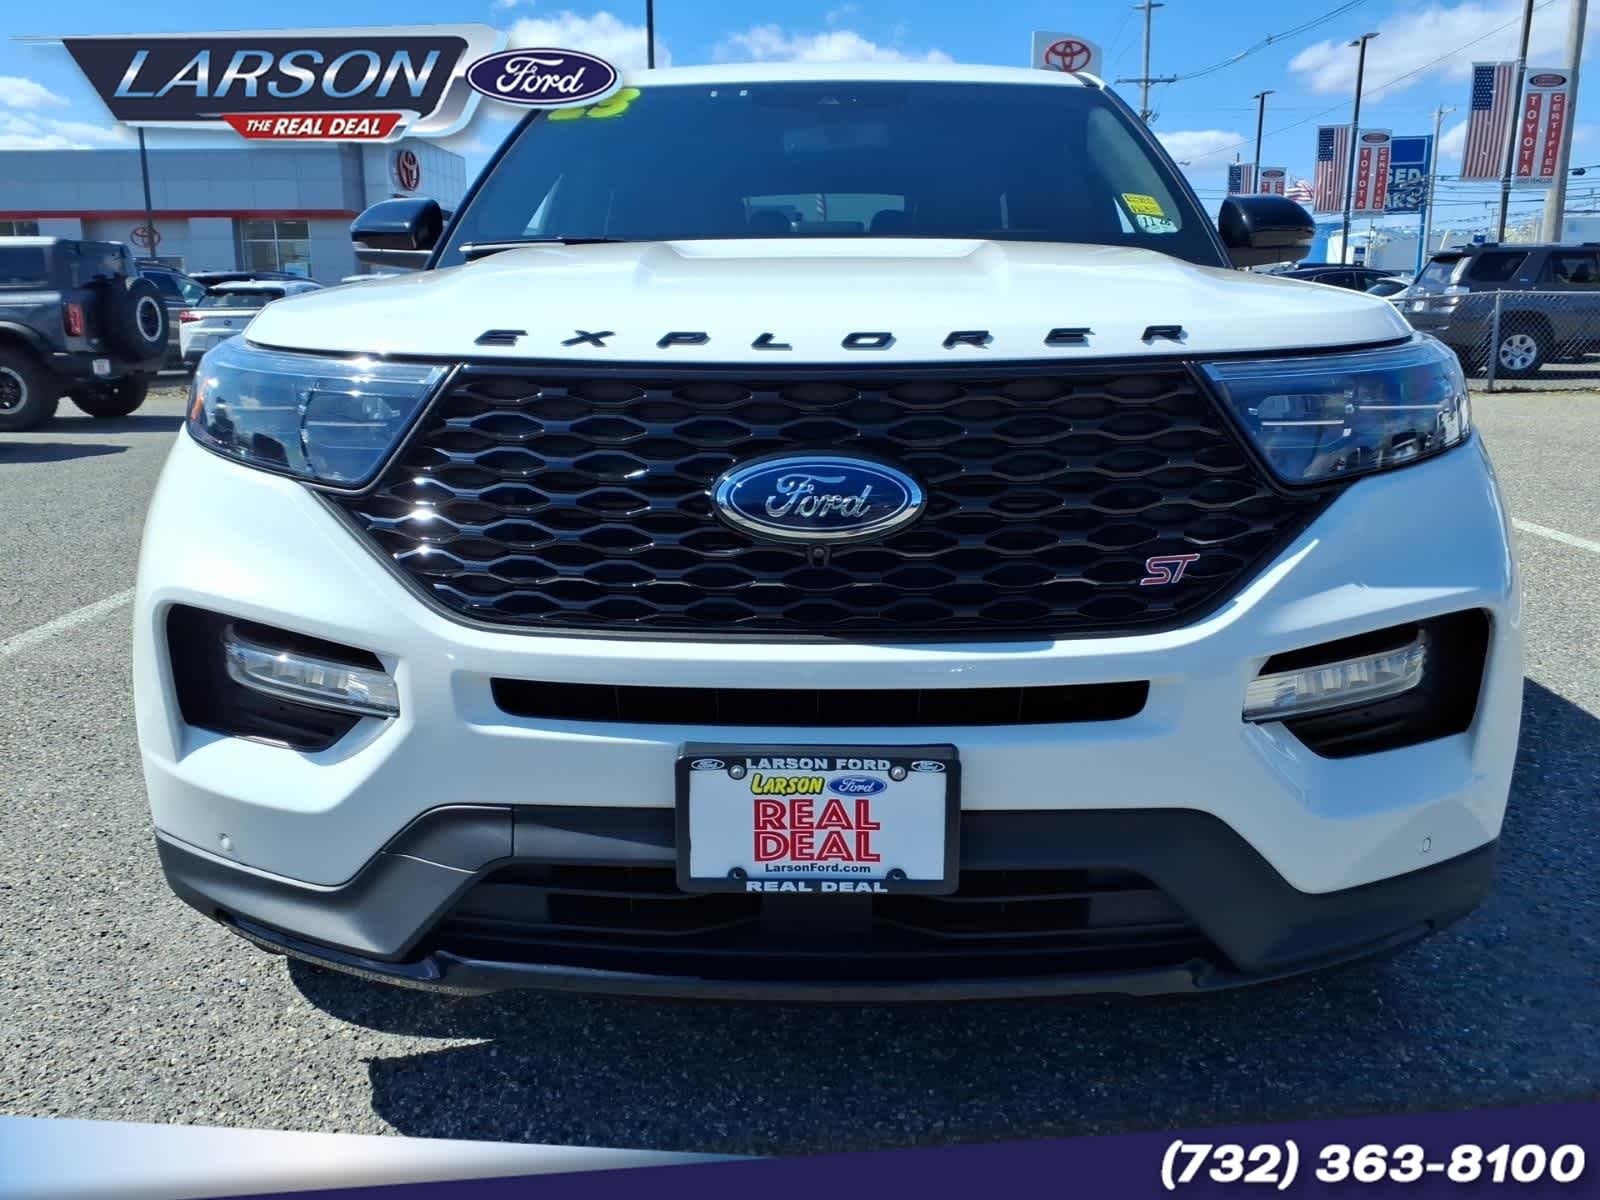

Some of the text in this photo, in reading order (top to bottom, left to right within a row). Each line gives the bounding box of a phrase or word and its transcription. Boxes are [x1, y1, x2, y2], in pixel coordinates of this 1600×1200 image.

[1520, 95, 1539, 174] TOYOTA
[1543, 95, 1562, 174] CERTIFIED
[474, 325, 1187, 351] EXPLORER
[765, 474, 873, 517] Ford
[1140, 553, 1200, 586] ST
[746, 758, 891, 770] LARSON FORD
[750, 773, 825, 796] LARSON
[838, 778, 875, 793] Ford
[754, 799, 881, 830] REAL
[754, 830, 881, 862] DEAL
[765, 863, 871, 873] LarsonFord.com
[746, 881, 888, 892] REAL DEAL
